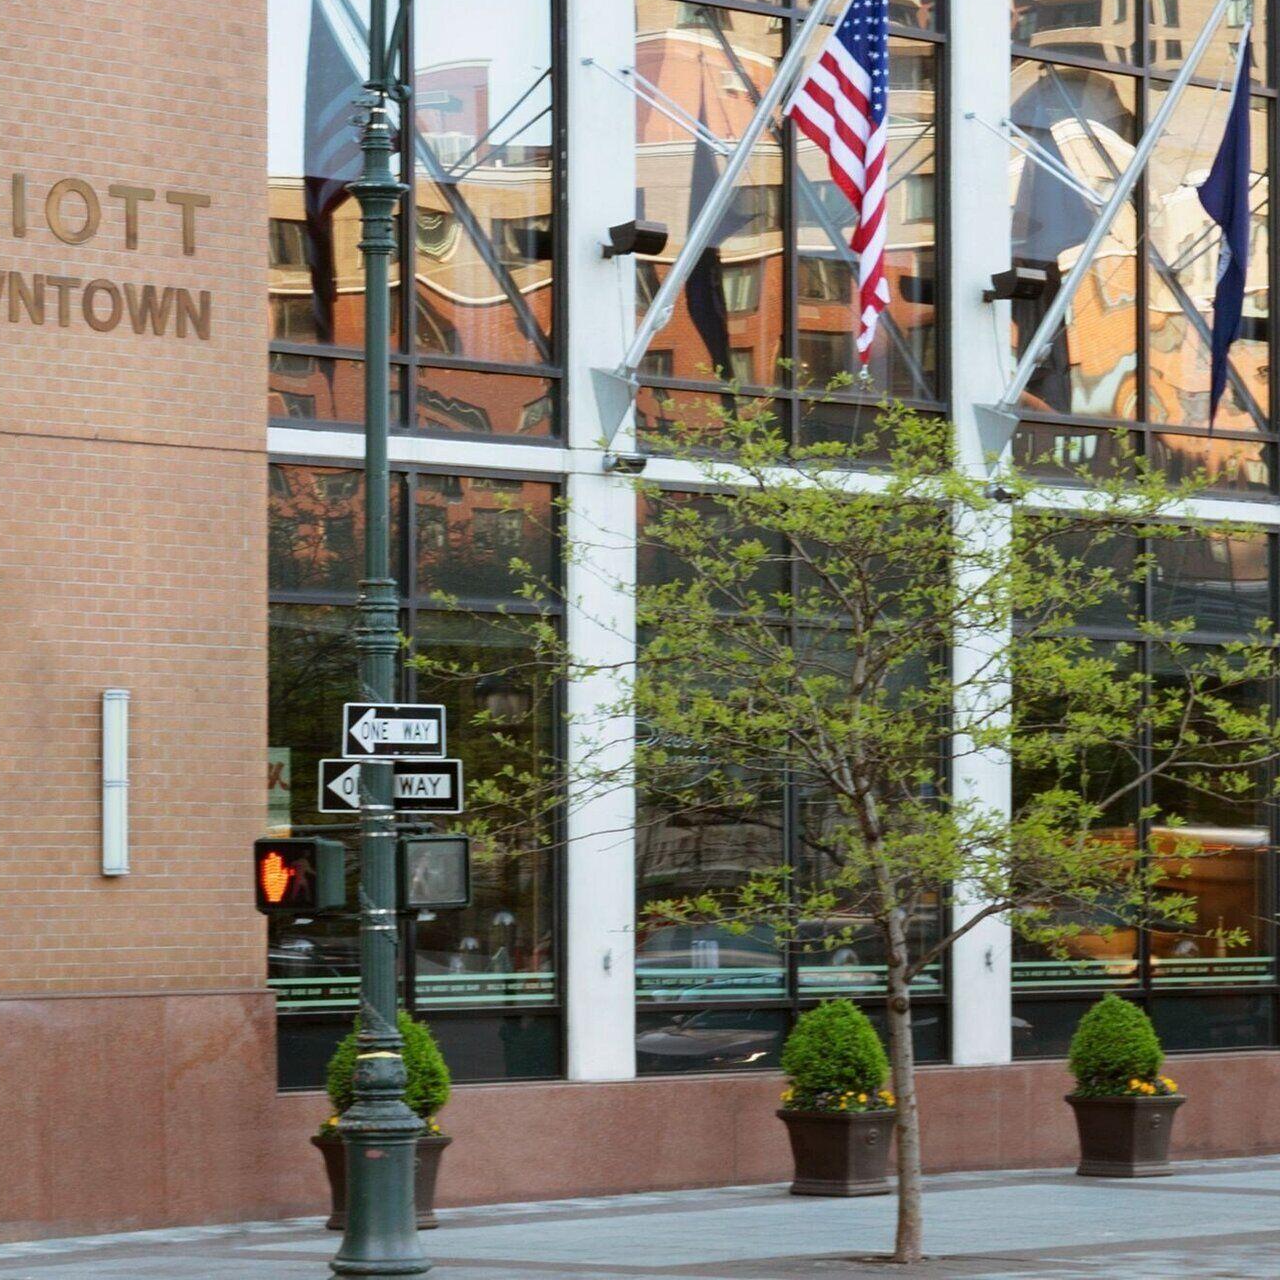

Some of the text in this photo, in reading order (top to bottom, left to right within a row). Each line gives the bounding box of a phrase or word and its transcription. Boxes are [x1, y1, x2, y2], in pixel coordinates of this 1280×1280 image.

[361, 721, 431, 740] ONE WAY
[400, 777, 441, 795] WAY
